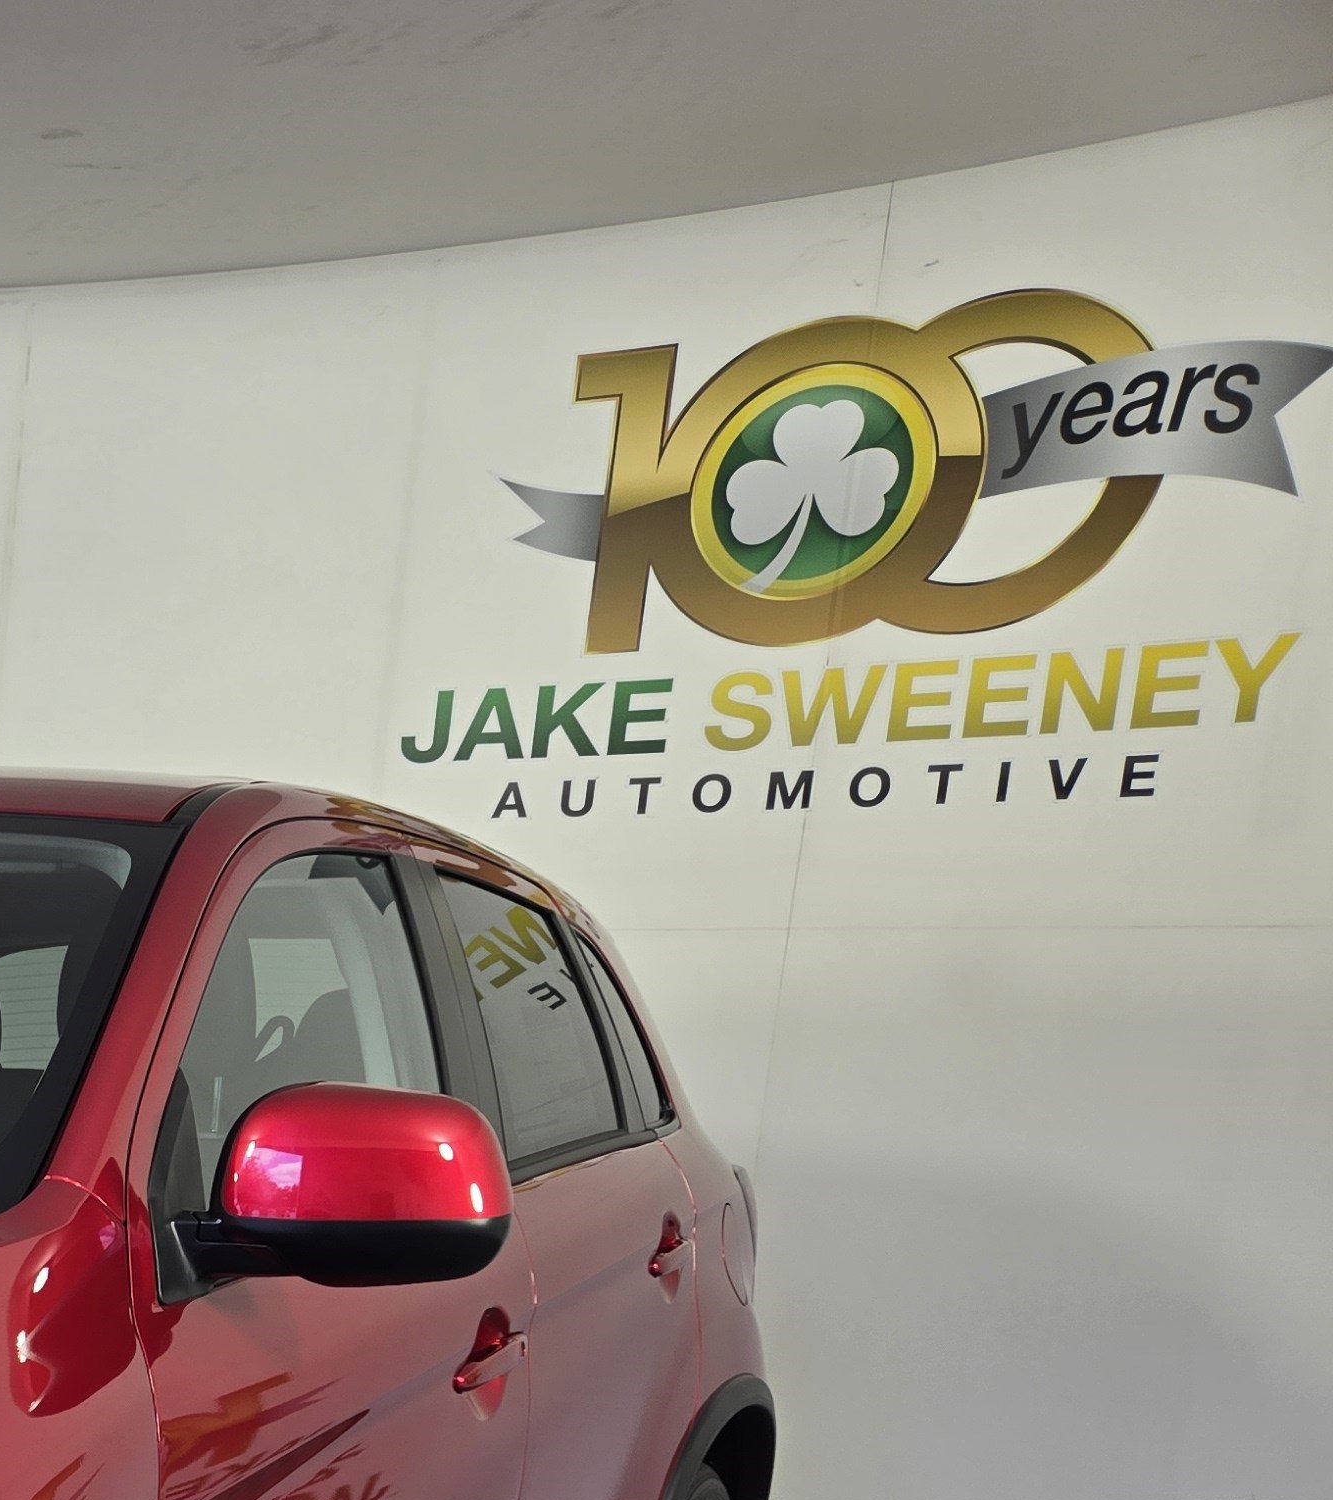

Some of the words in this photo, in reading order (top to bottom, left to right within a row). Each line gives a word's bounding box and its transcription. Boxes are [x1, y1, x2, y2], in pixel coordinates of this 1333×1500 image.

[1001, 362, 1260, 479] years
[400, 678, 674, 765] JAKE
[704, 632, 1301, 752] SWEENEY
[490, 753, 1160, 819] AUTOMOTIVE
